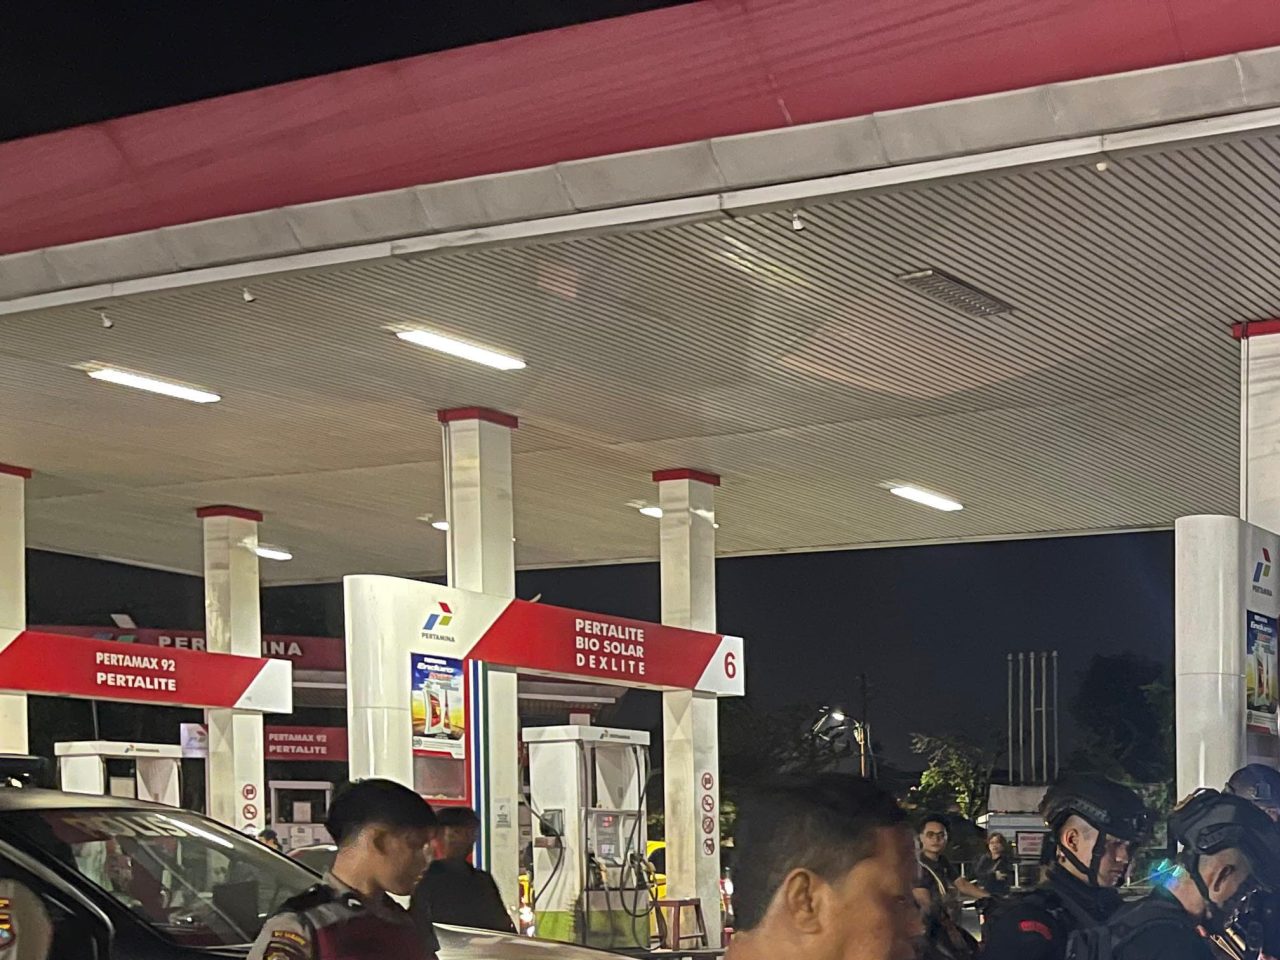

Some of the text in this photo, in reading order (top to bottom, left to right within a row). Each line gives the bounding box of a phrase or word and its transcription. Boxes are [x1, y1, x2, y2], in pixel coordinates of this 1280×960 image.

[575, 618, 645, 642] PERTALITE
[158, 635, 303, 656] PERINA
[575, 636, 645, 659] BIO SOLAR
[95, 652, 176, 672] PERTAMAX 92
[575, 652, 646, 675] DEXLITE
[723, 651, 737, 679] 6
[96, 672, 177, 692] PERTALITE
[269, 745, 328, 755] PERTALITE
